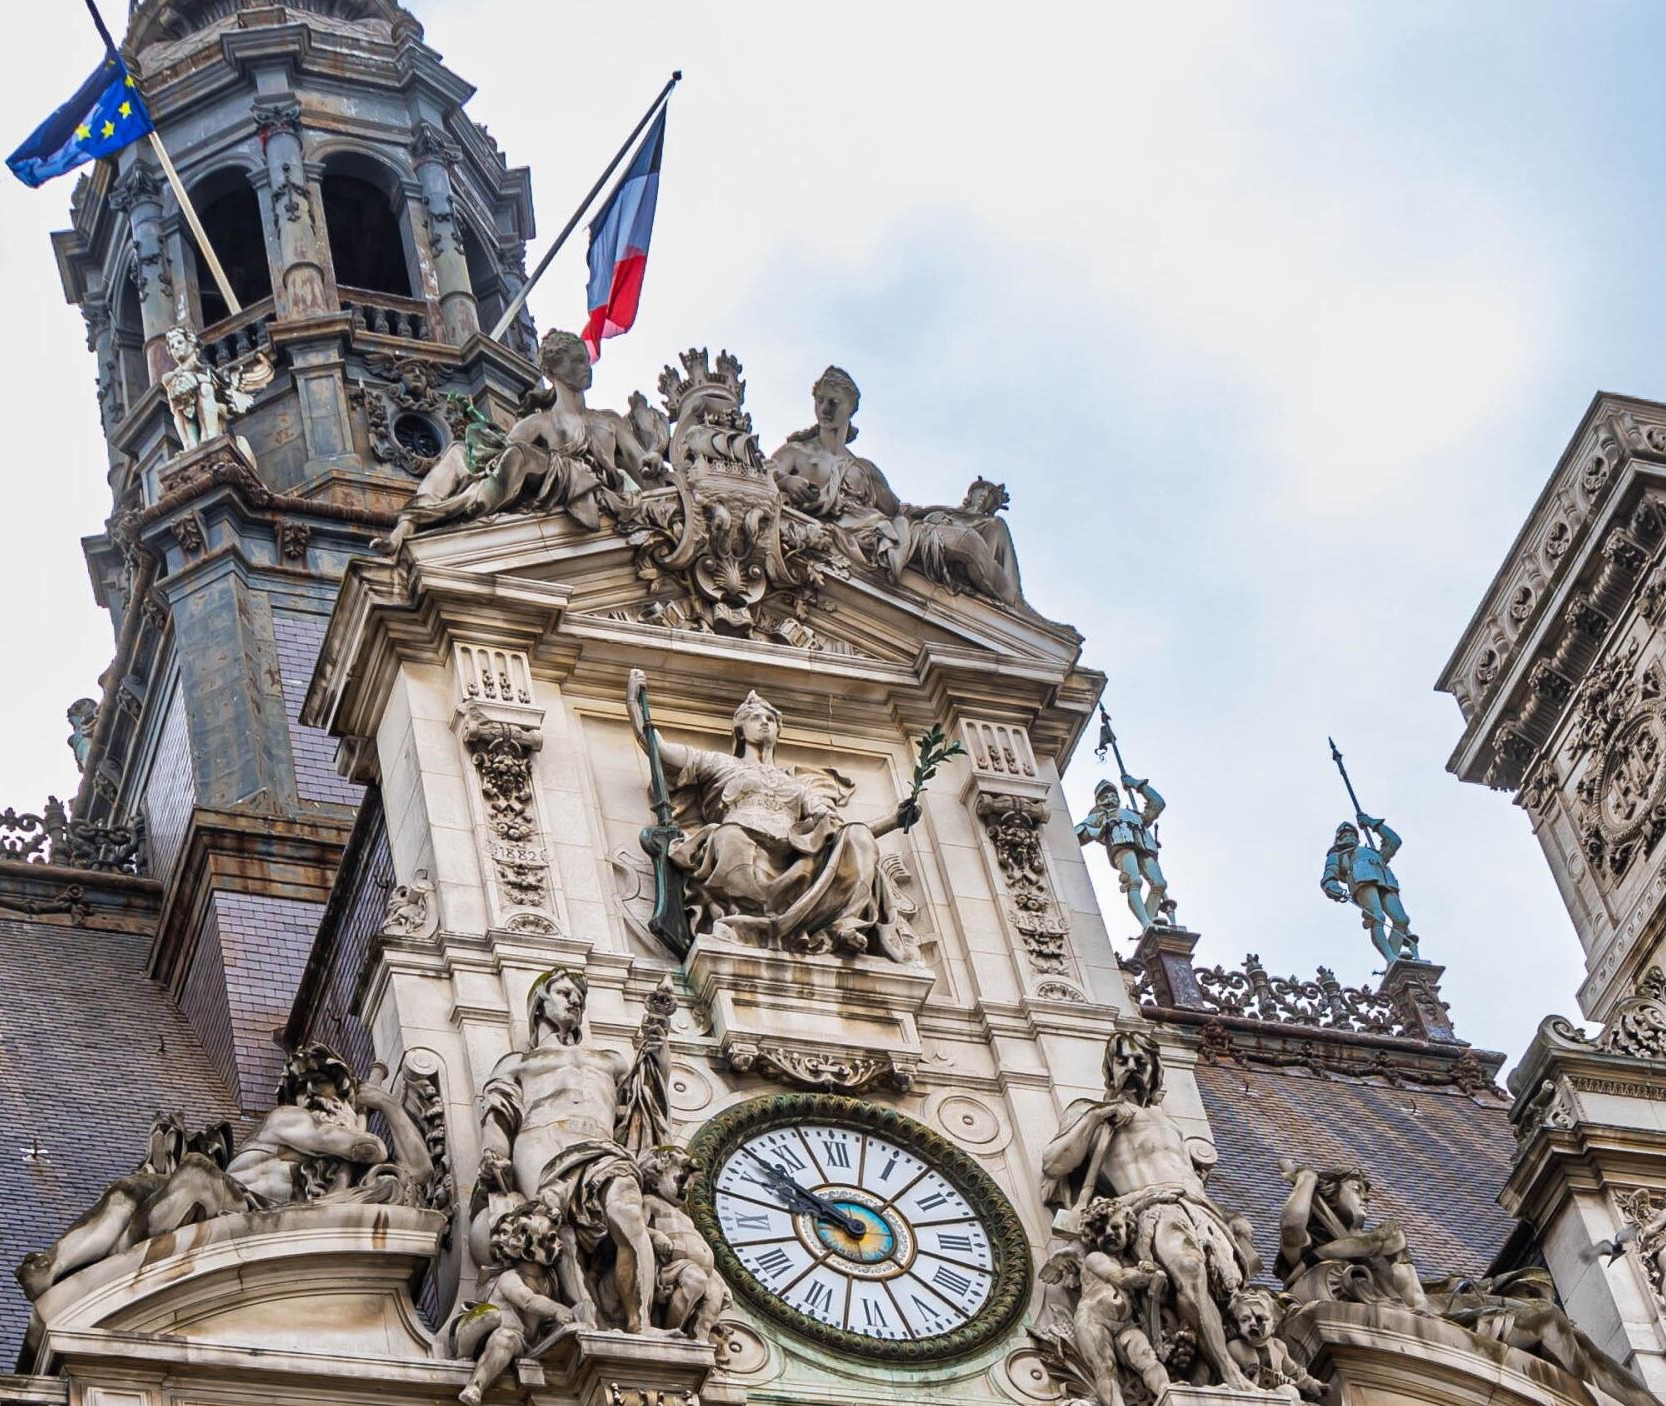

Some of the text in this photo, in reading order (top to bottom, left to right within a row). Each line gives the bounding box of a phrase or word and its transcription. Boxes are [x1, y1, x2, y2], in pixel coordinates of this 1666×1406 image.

[771, 1144, 808, 1173] XI
[822, 1140, 852, 1169] XII
[916, 1192, 950, 1212] II
[735, 1212, 771, 1232] IX
[937, 1232, 974, 1253] III
[754, 1247, 794, 1279] VIII
[932, 1265, 972, 1296] IIII
[803, 1280, 833, 1313] VII
[910, 1294, 941, 1321] V
[862, 1298, 889, 1327] VI
